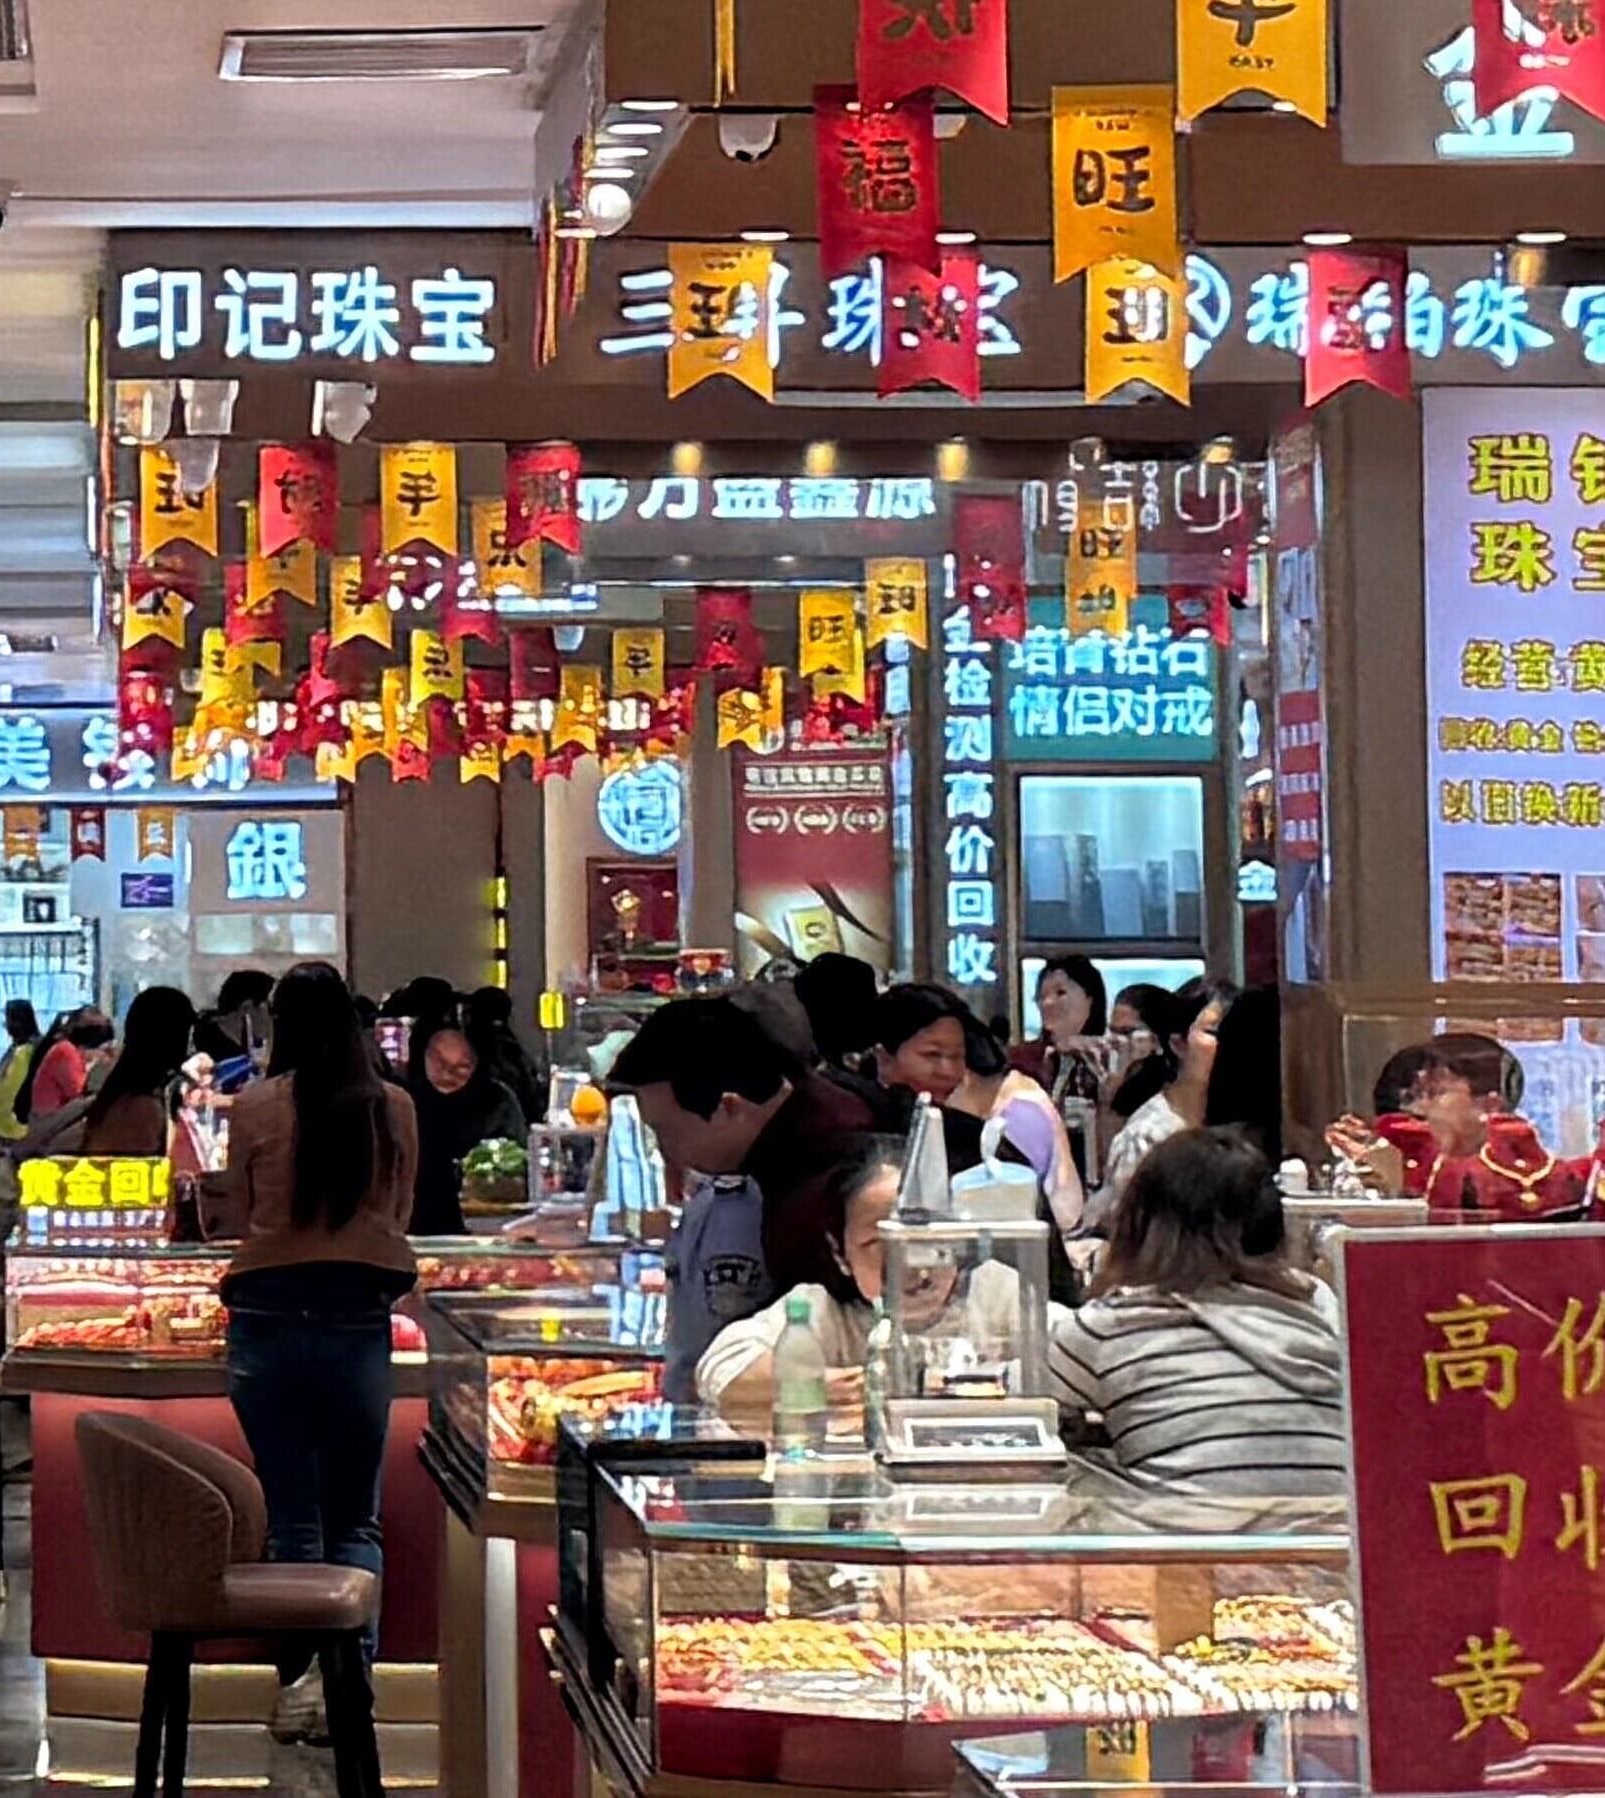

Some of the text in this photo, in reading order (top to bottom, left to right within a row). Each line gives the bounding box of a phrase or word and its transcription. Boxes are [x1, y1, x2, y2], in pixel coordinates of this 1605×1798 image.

[839, 138, 917, 213] 福
[1074, 145, 1155, 212] 旺
[117, 267, 495, 363] 印记珠宝
[1008, 684, 1214, 736] 情侣对戒
[226, 819, 306, 899] 銀
